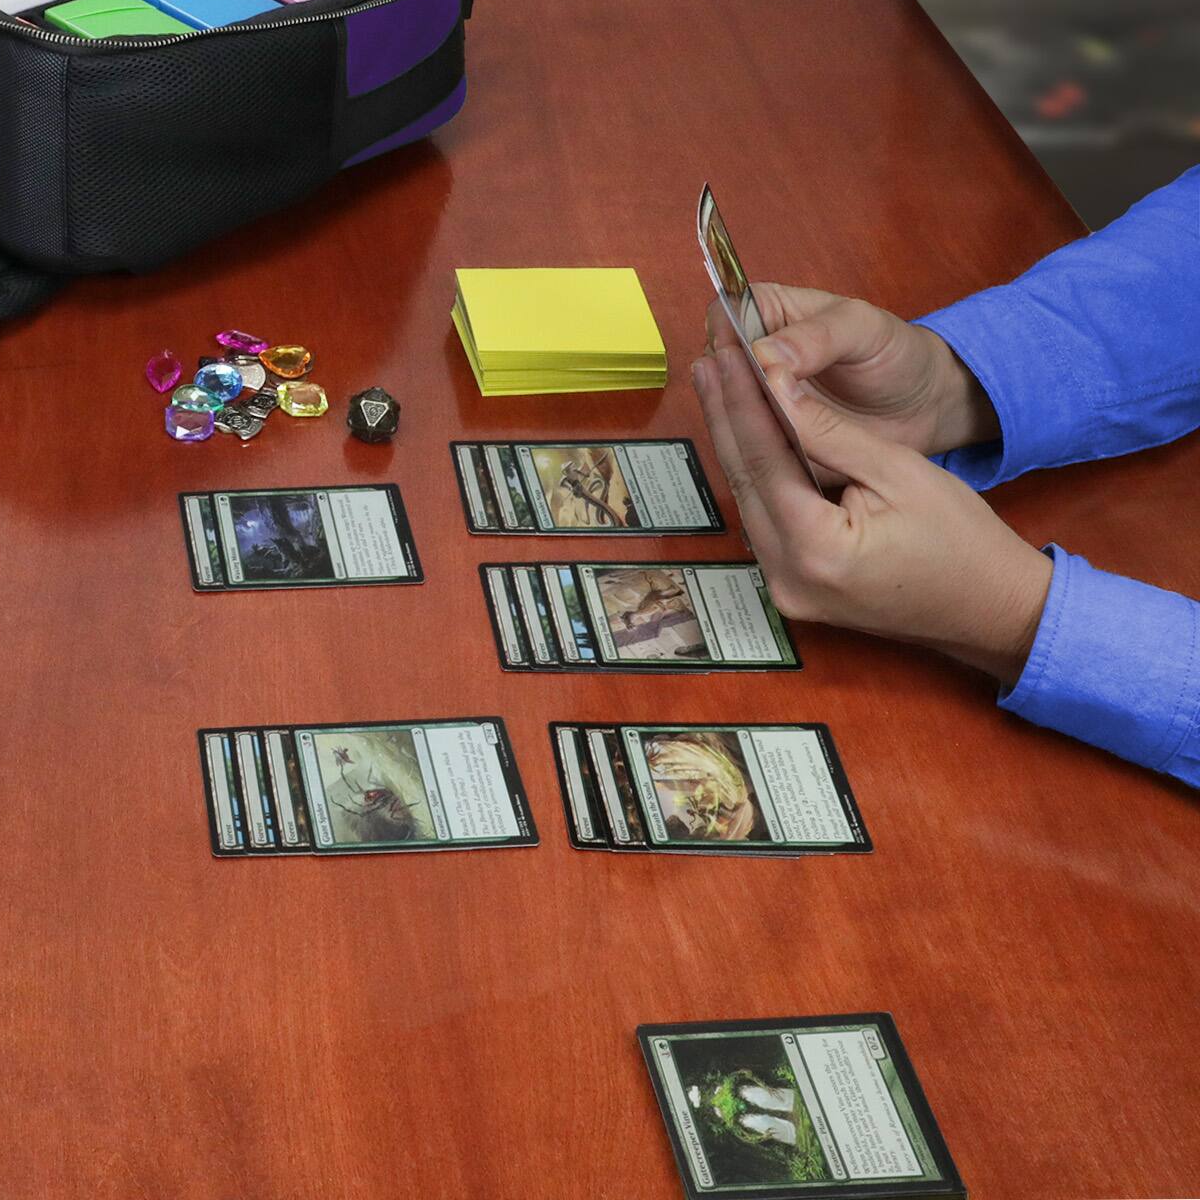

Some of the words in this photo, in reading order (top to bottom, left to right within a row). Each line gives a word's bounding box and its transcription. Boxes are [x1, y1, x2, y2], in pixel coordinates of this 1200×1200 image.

[511, 643, 519, 660] Forest
[539, 642, 548, 660] Forest
[569, 641, 578, 659] Forest
[428, 789, 439, 807] Spider
[642, 781, 654, 799] Sands
[315, 802, 326, 823] Spider
[647, 801, 657, 810] the
[226, 824, 234, 844] Forest
[257, 822, 265, 842] Forest
[288, 821, 296, 842] Forest
[319, 825, 330, 842] Giant
[435, 815, 446, 837] Creature
[582, 817, 592, 837] Forest
[617, 819, 628, 840] Forest
[651, 812, 665, 838] Beneath
[678, 1110, 693, 1128] Vine
[814, 1115, 828, 1134] Plant
[685, 1130, 710, 1184] Gatecreeper
[825, 1144, 843, 1175] Creature
